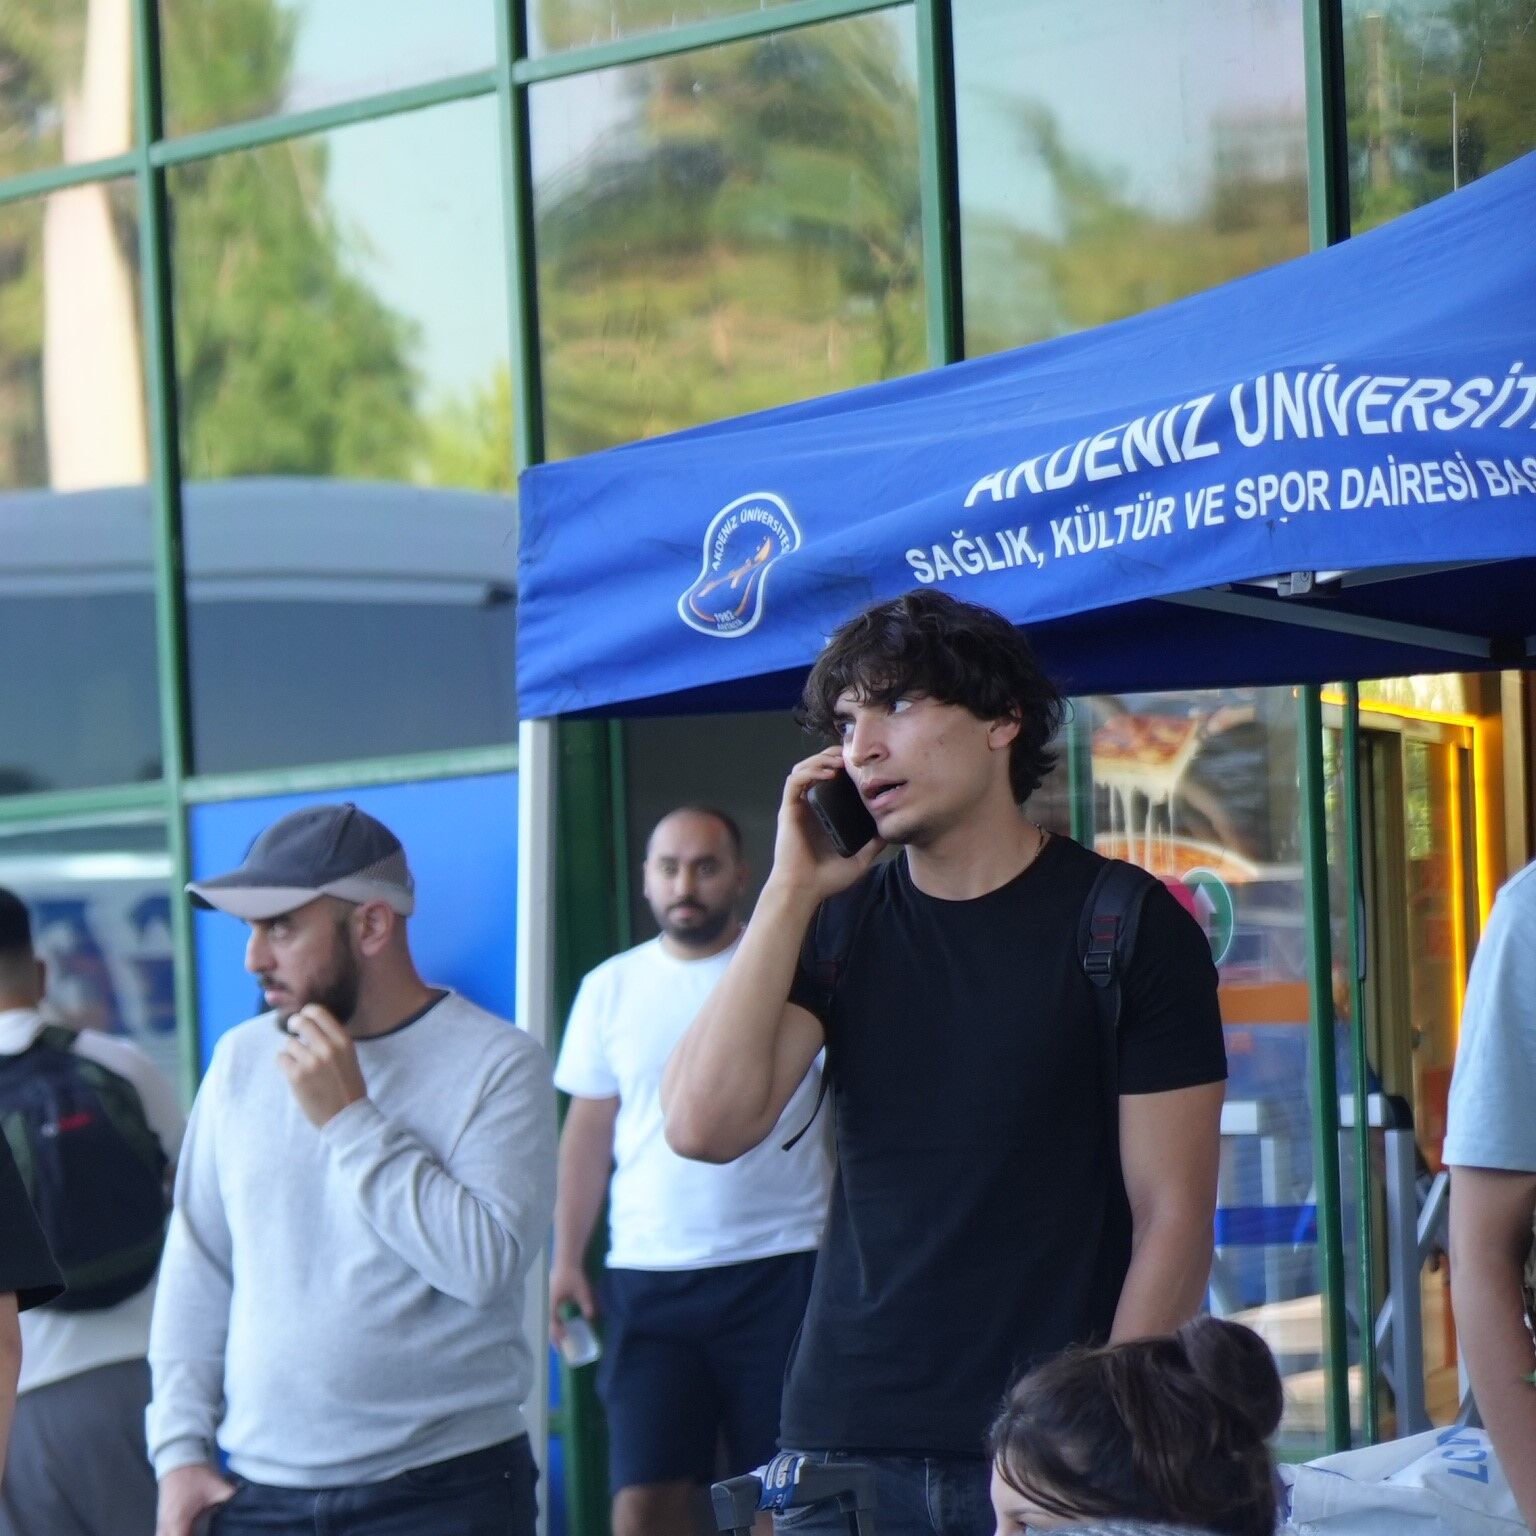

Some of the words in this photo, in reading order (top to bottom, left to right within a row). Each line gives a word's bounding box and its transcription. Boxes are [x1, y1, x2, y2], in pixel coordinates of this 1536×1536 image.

[905, 528, 1045, 584] SAĞLIK,
[1050, 492, 1175, 558] KÜLTÜR
[1185, 483, 1225, 529] VE
[1234, 470, 1331, 521] SPOR
[1340, 451, 1479, 510] DAİRESİ
